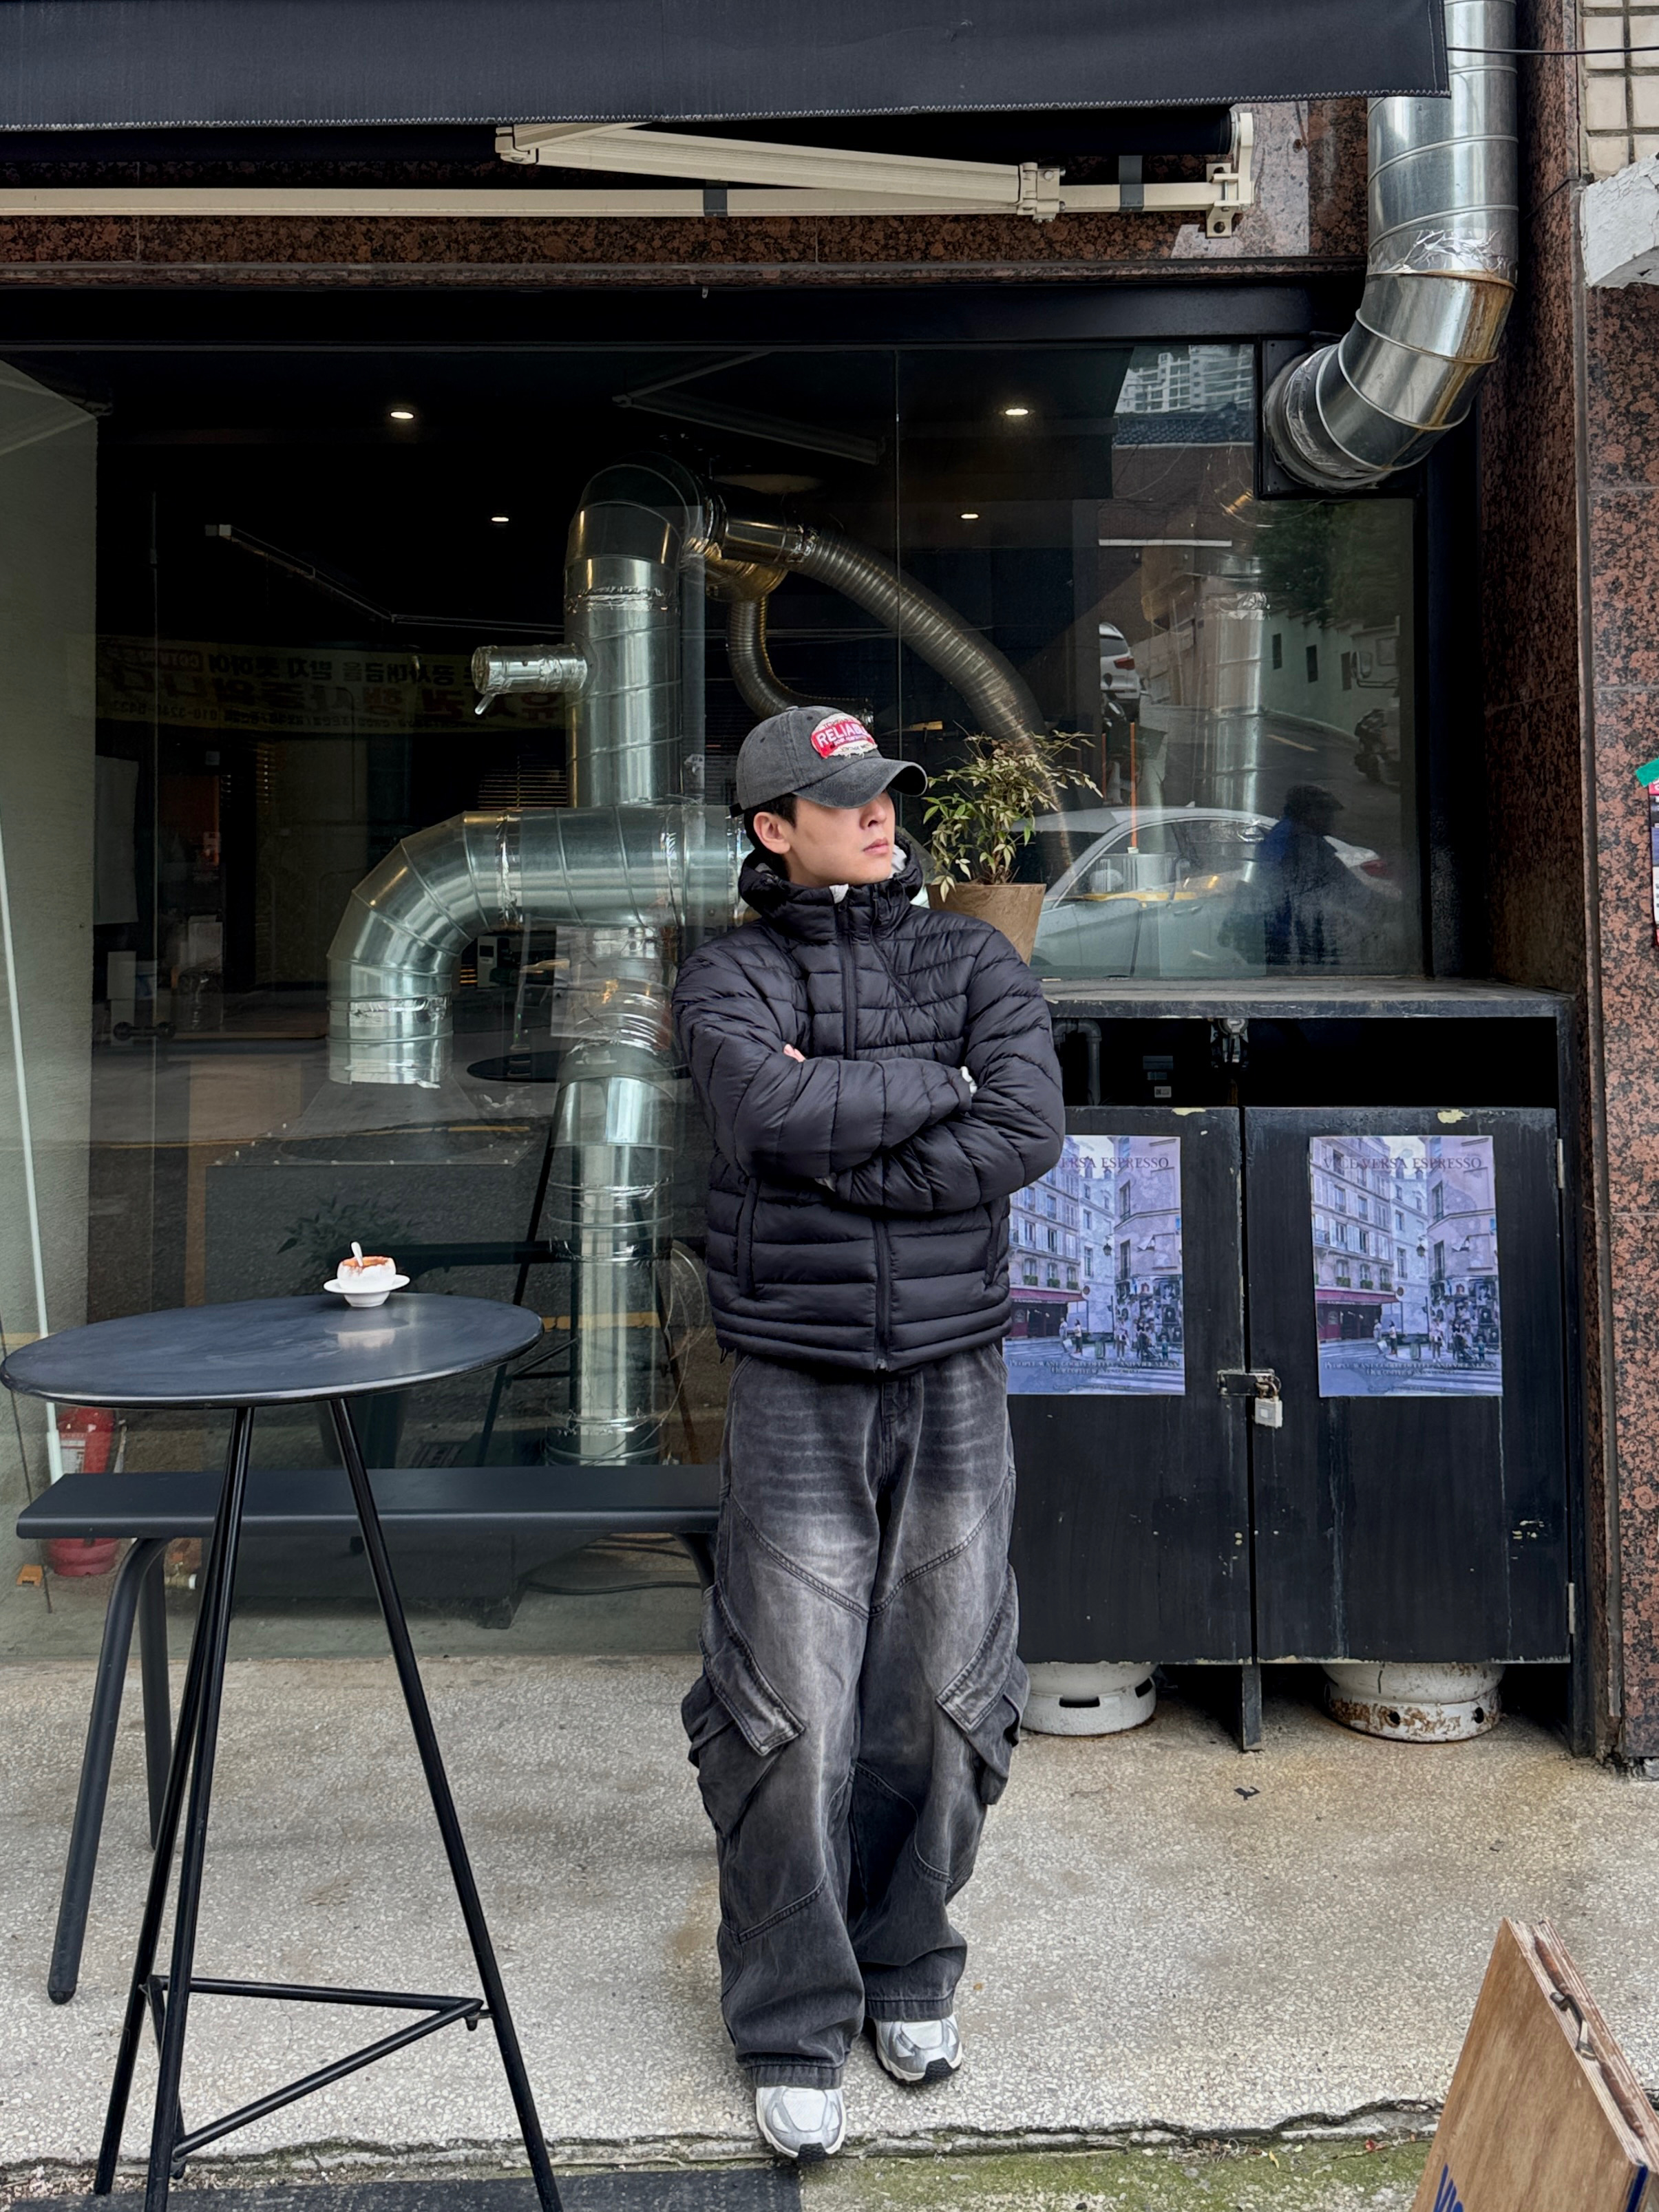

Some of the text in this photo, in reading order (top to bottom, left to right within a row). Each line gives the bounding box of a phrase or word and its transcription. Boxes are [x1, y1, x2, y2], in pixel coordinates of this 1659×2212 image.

[1061, 1157, 1170, 1169] ERSA ESPRESSO
[1324, 1157, 1482, 1169] VCE VERSA ESPRESSO
